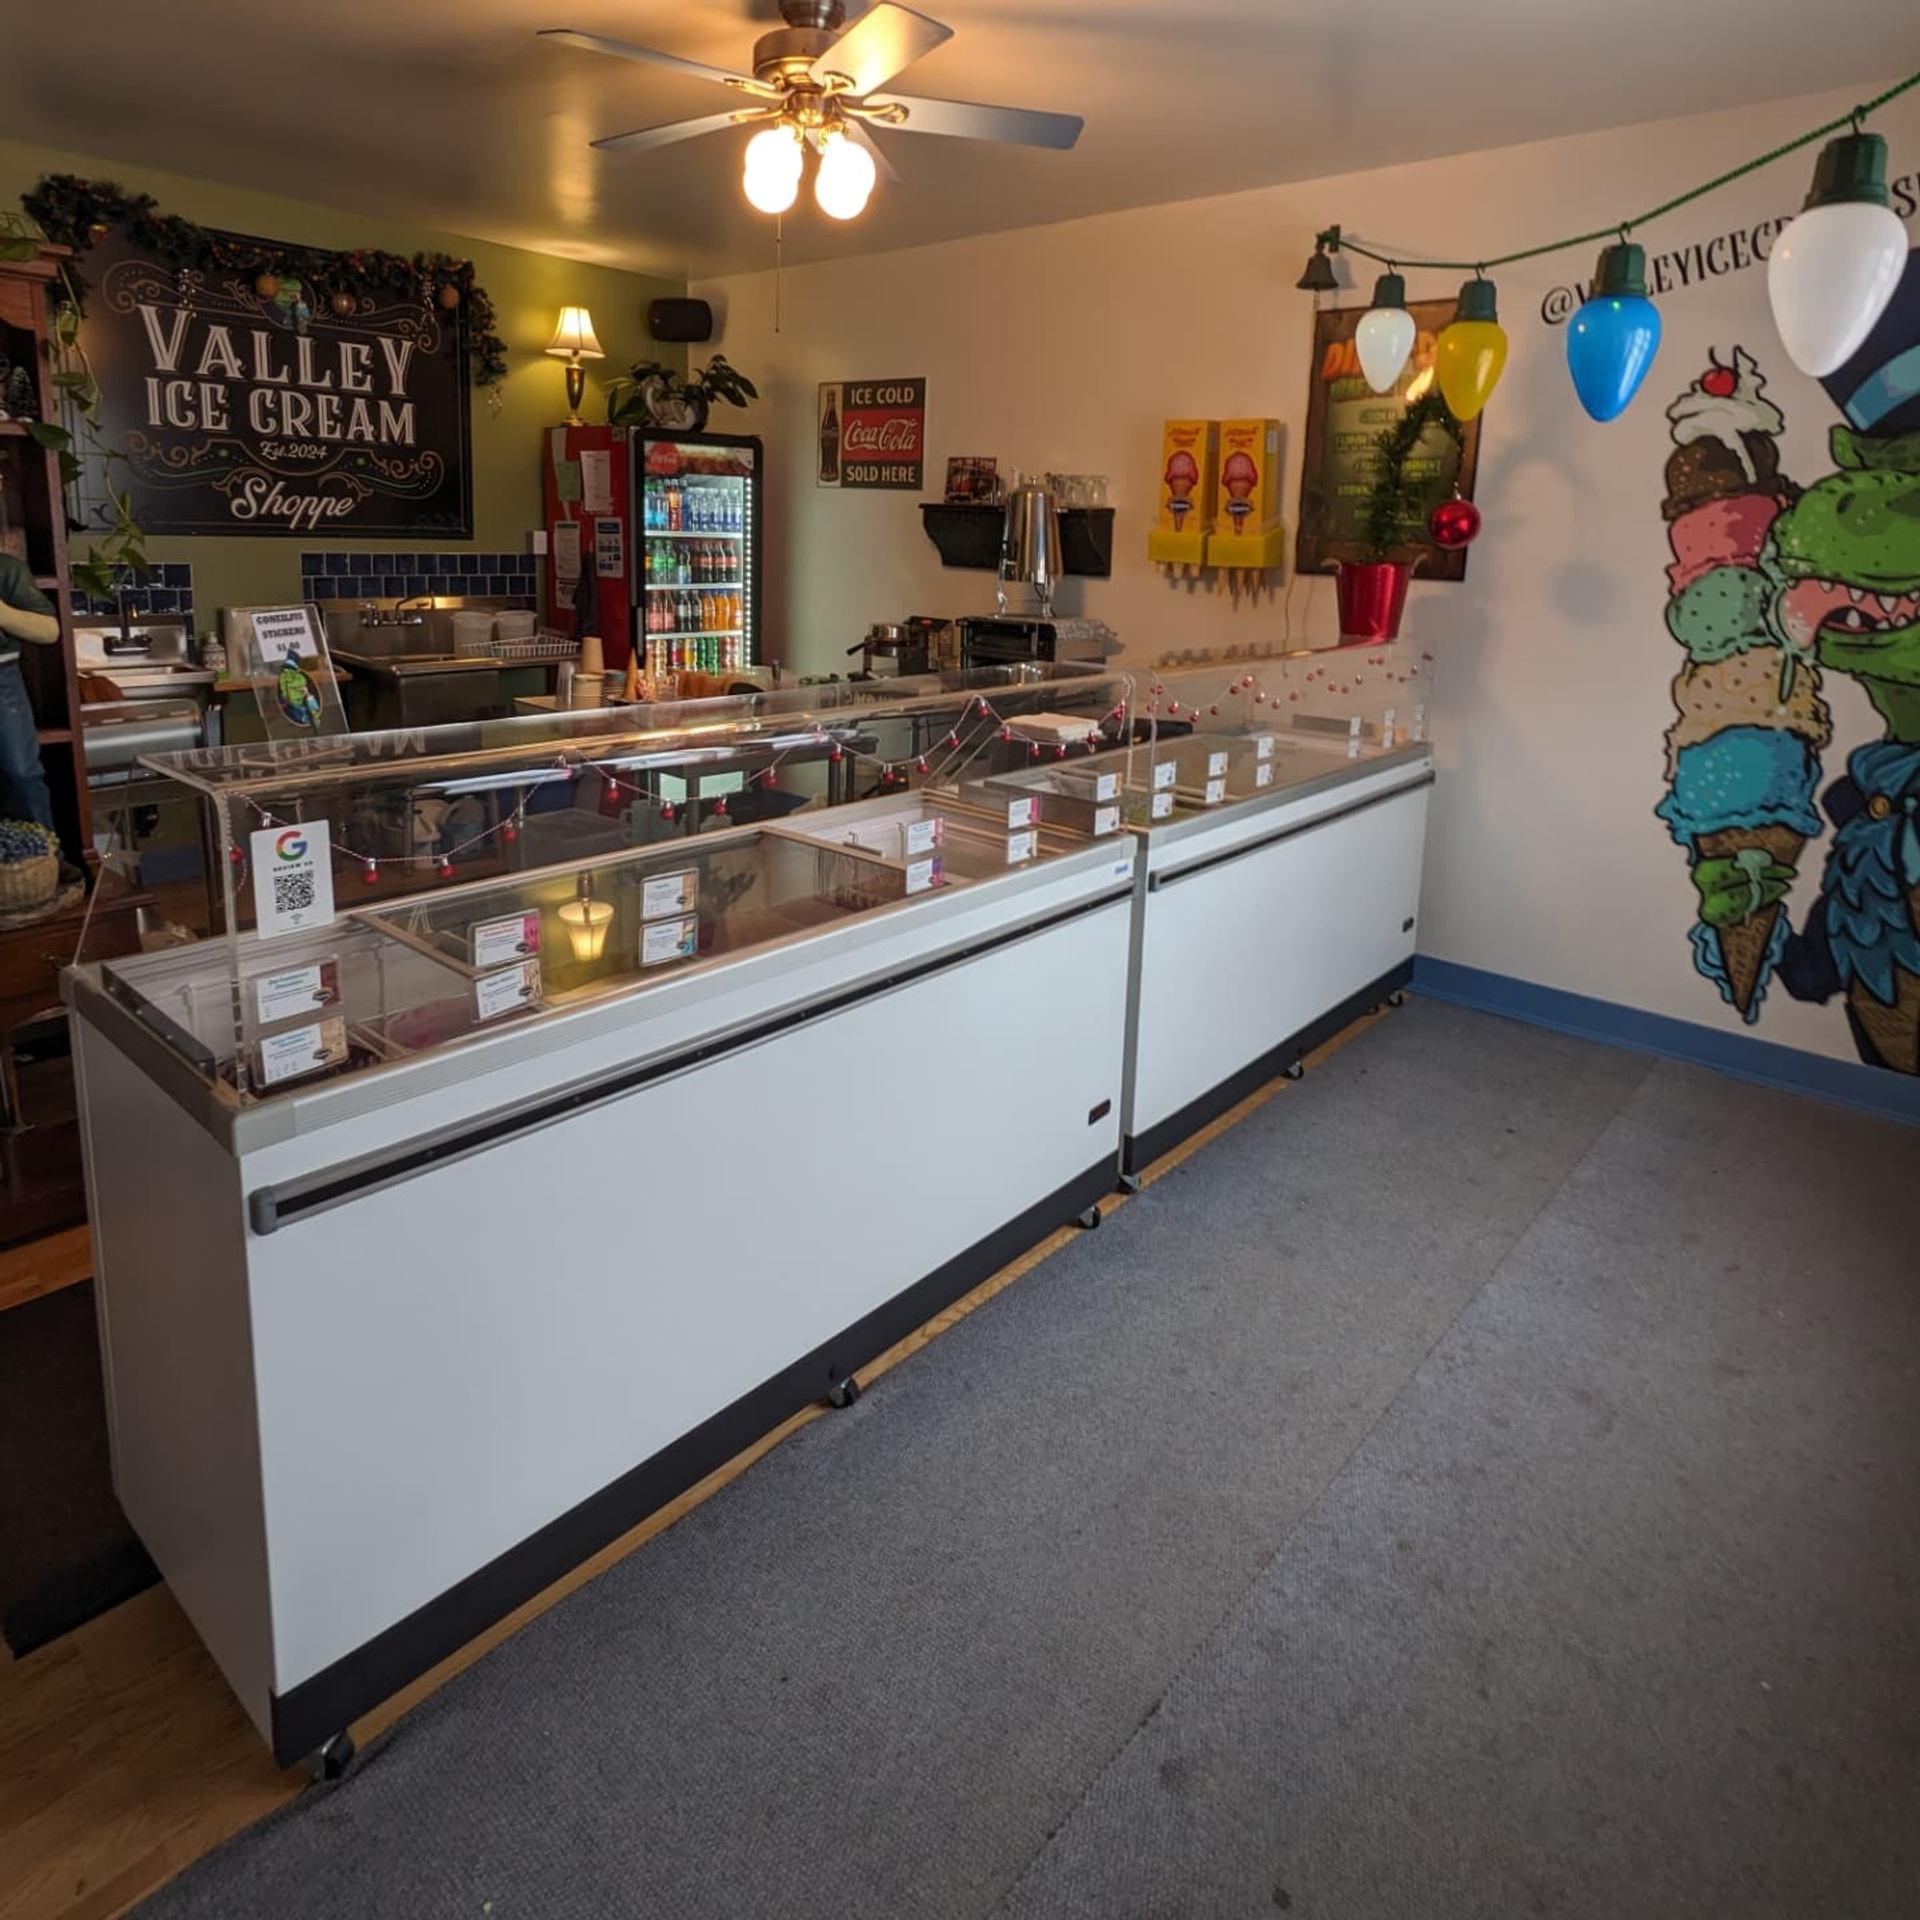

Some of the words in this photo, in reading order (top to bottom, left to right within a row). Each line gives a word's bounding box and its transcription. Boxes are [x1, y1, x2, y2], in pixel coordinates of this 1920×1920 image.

[137, 303, 417, 396] VALLEY
[145, 376, 230, 432] ICE
[249, 388, 414, 446] CREAM
[851, 388, 873, 405] ICE
[876, 386, 914, 404] COLD
[844, 418, 918, 450] Coca-Cola
[846, 465, 879, 481] SOLD
[881, 465, 916, 483] HERE
[230, 476, 356, 530] Shoppe
